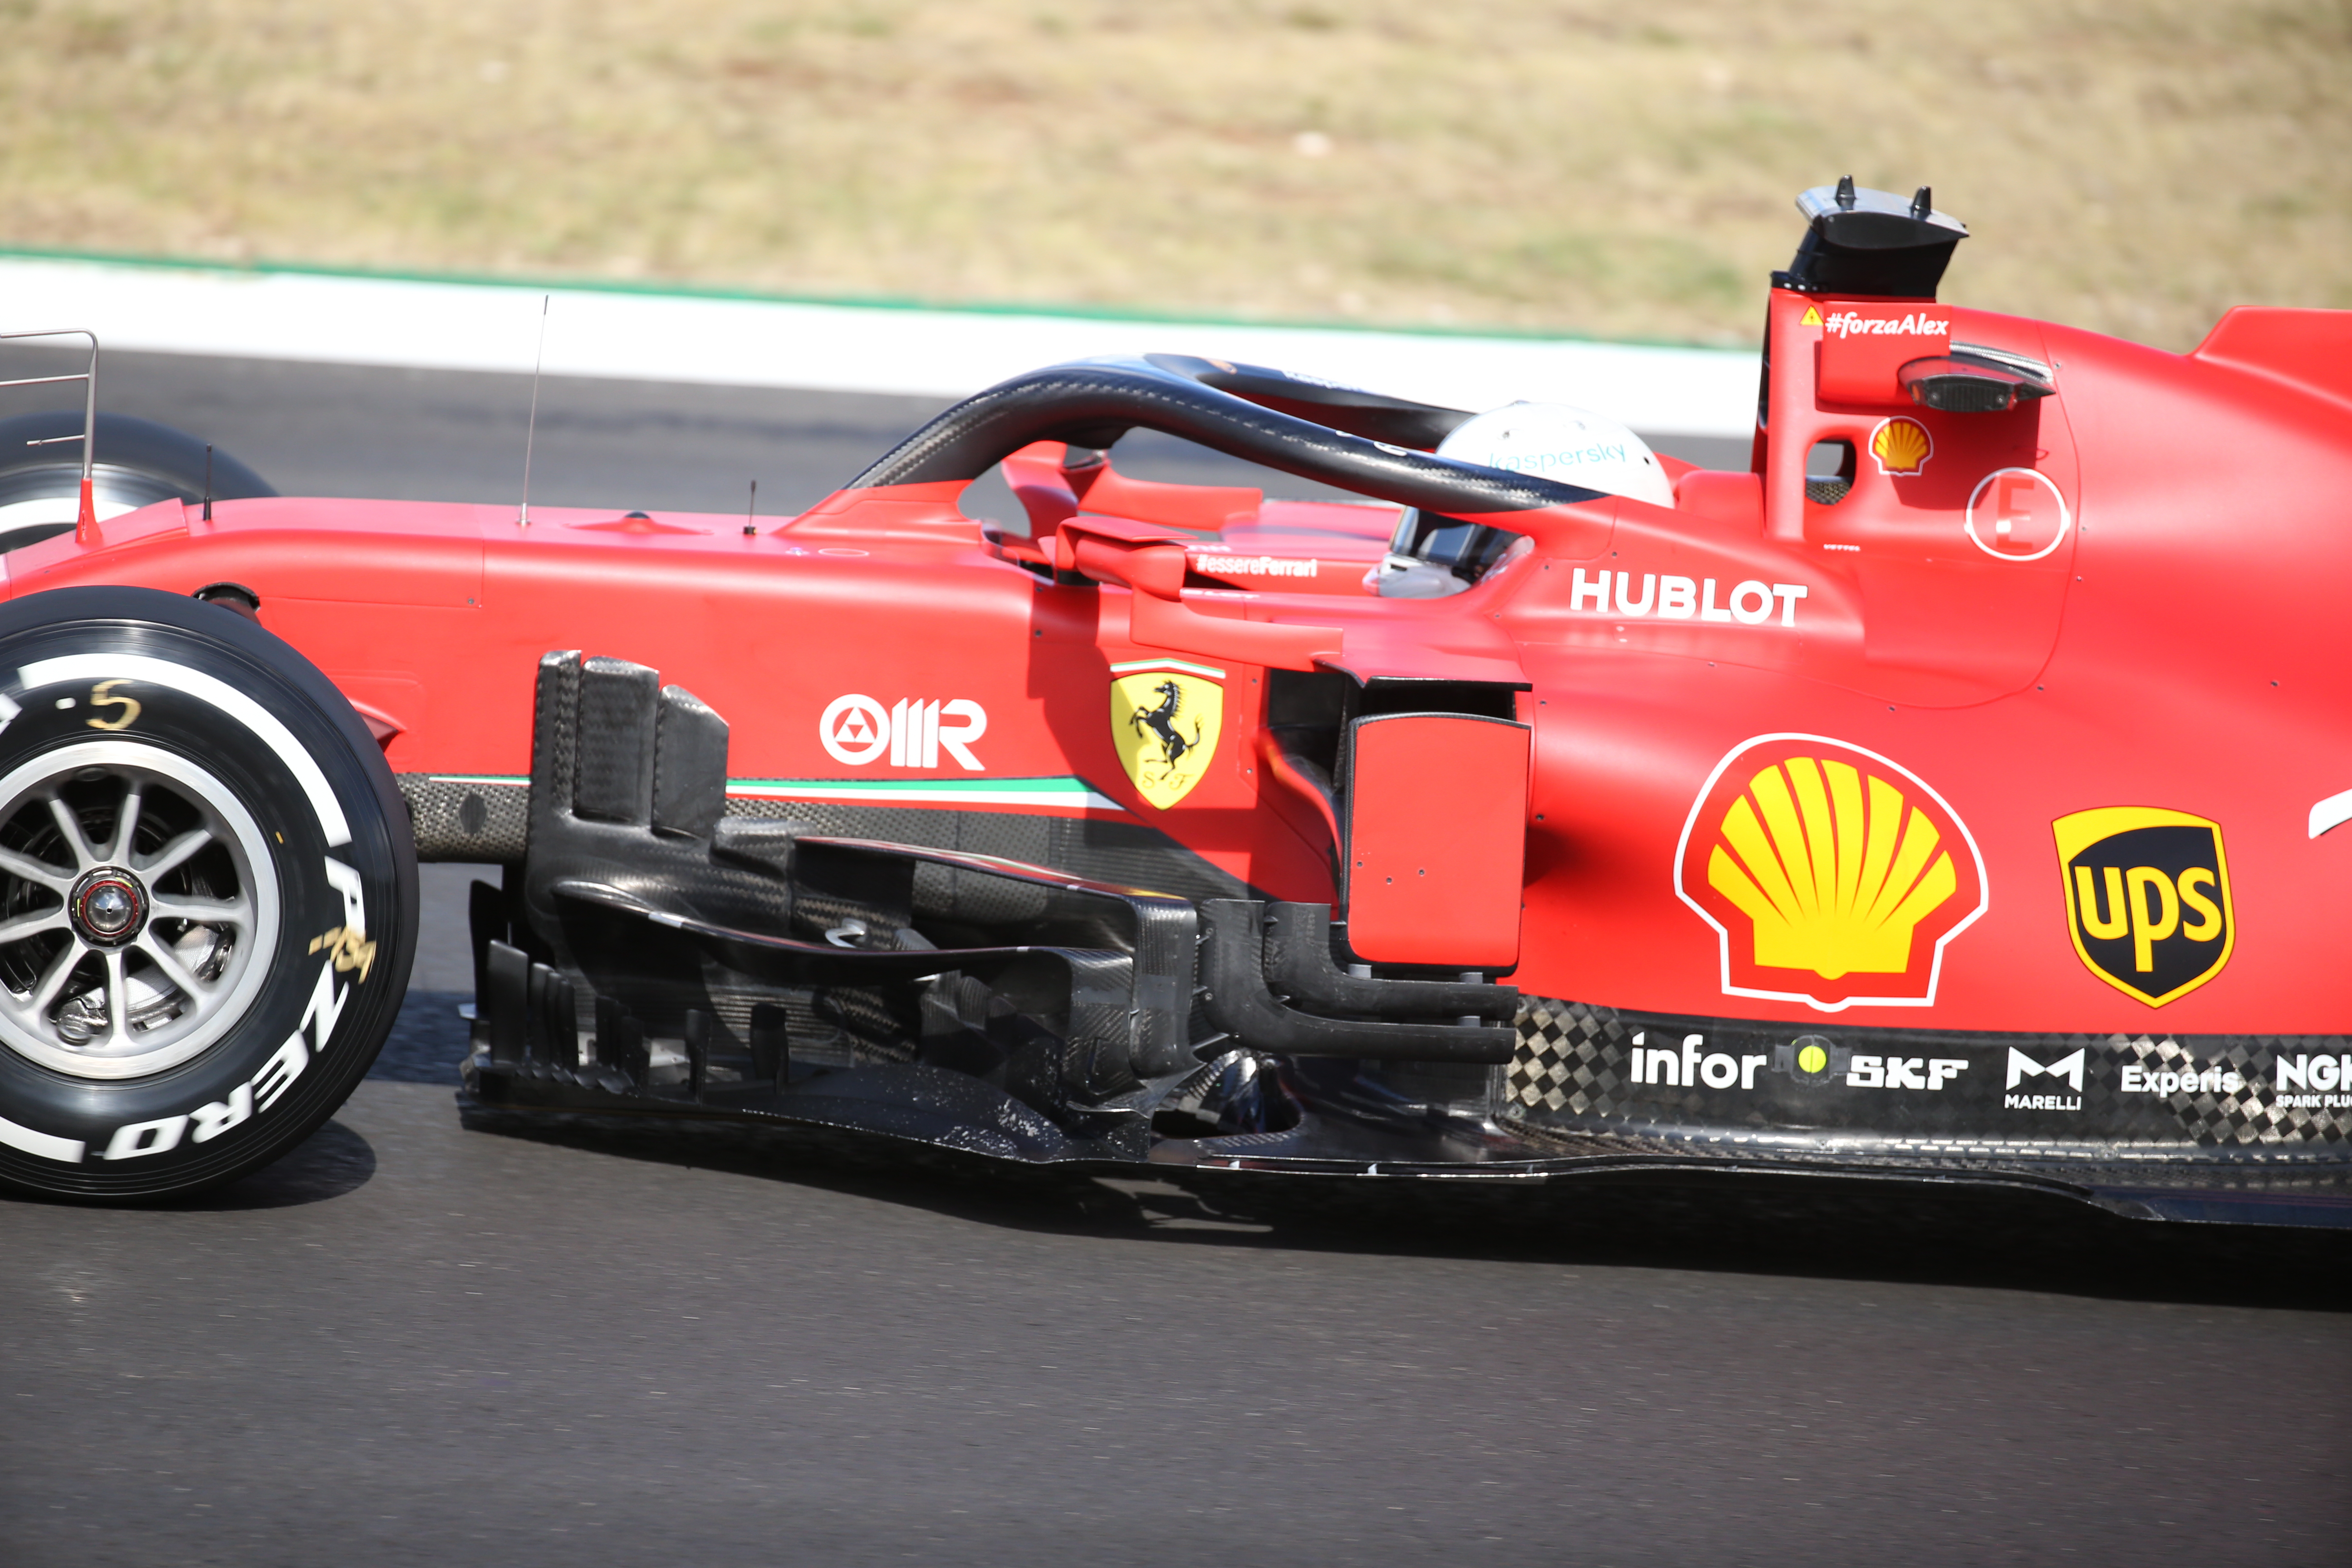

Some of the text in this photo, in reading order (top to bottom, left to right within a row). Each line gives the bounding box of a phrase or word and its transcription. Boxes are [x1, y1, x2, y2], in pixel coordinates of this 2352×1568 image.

[1824, 311, 1950, 339] #forzaAlex
[1489, 443, 1627, 472] kaspersky
[1196, 554, 1318, 578] #essereFerrari
[1569, 567, 1808, 627] HUBLOT
[1142, 771, 1155, 789] S
[2074, 866, 2223, 973] ups
[102, 959, 350, 1161] ZERO
[1630, 1031, 1768, 1090] infor
[1846, 1055, 1969, 1091] SKF
[2121, 1065, 2240, 1098] Experis
[2004, 1094, 2082, 1111] MARELLI
[2275, 1094, 2352, 1108] SPARK PLU
